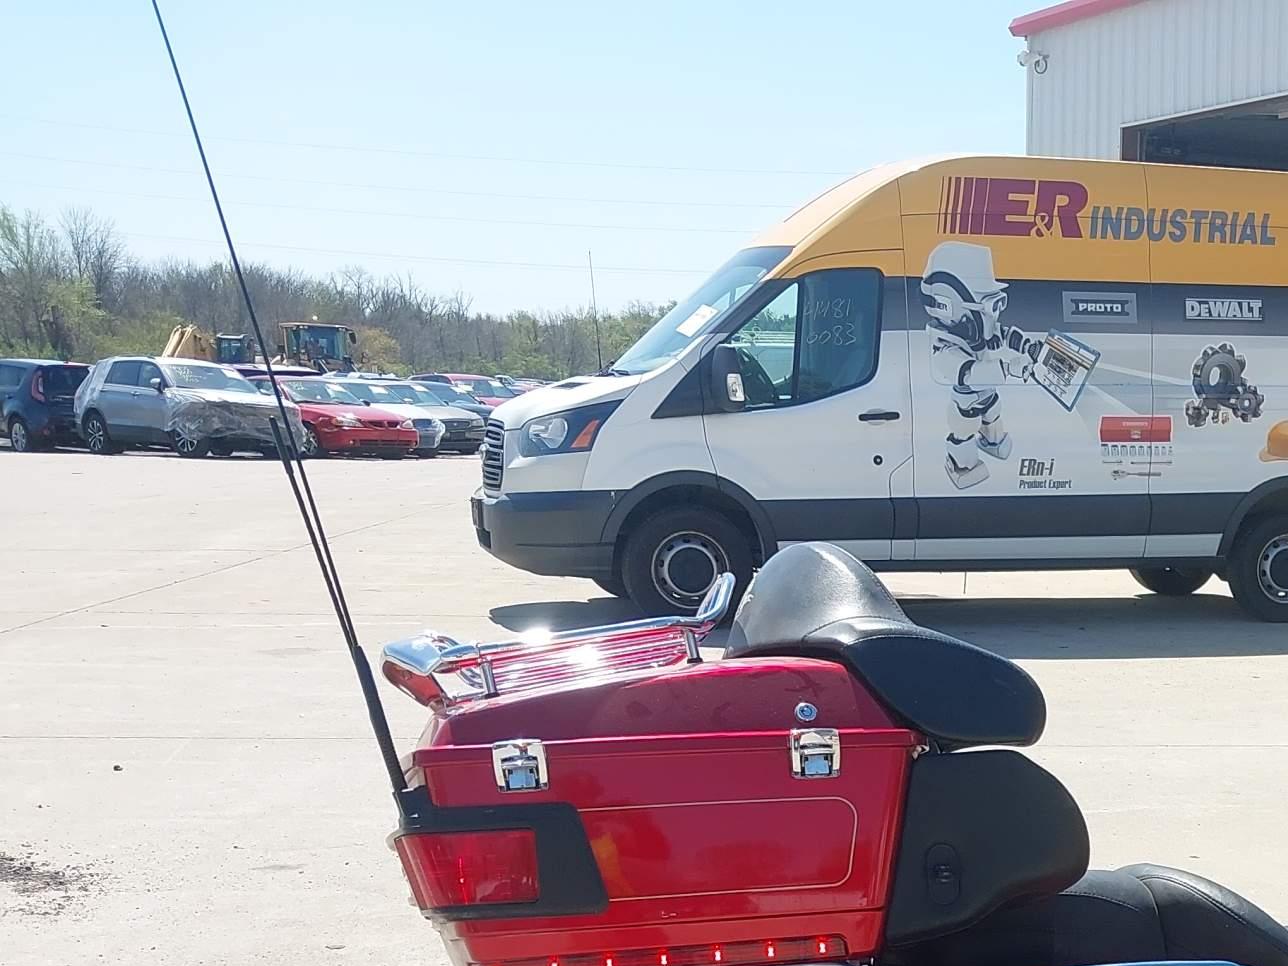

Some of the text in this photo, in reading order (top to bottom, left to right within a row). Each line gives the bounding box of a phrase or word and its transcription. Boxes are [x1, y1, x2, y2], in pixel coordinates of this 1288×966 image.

[1089, 205, 1276, 246] INDUSTRIAL
[1078, 302, 1122, 313] PROTO
[806, 322, 857, 346] 0083
[1019, 458, 1055, 477] ERn-i
[1019, 479, 1072, 491] Product Expert
